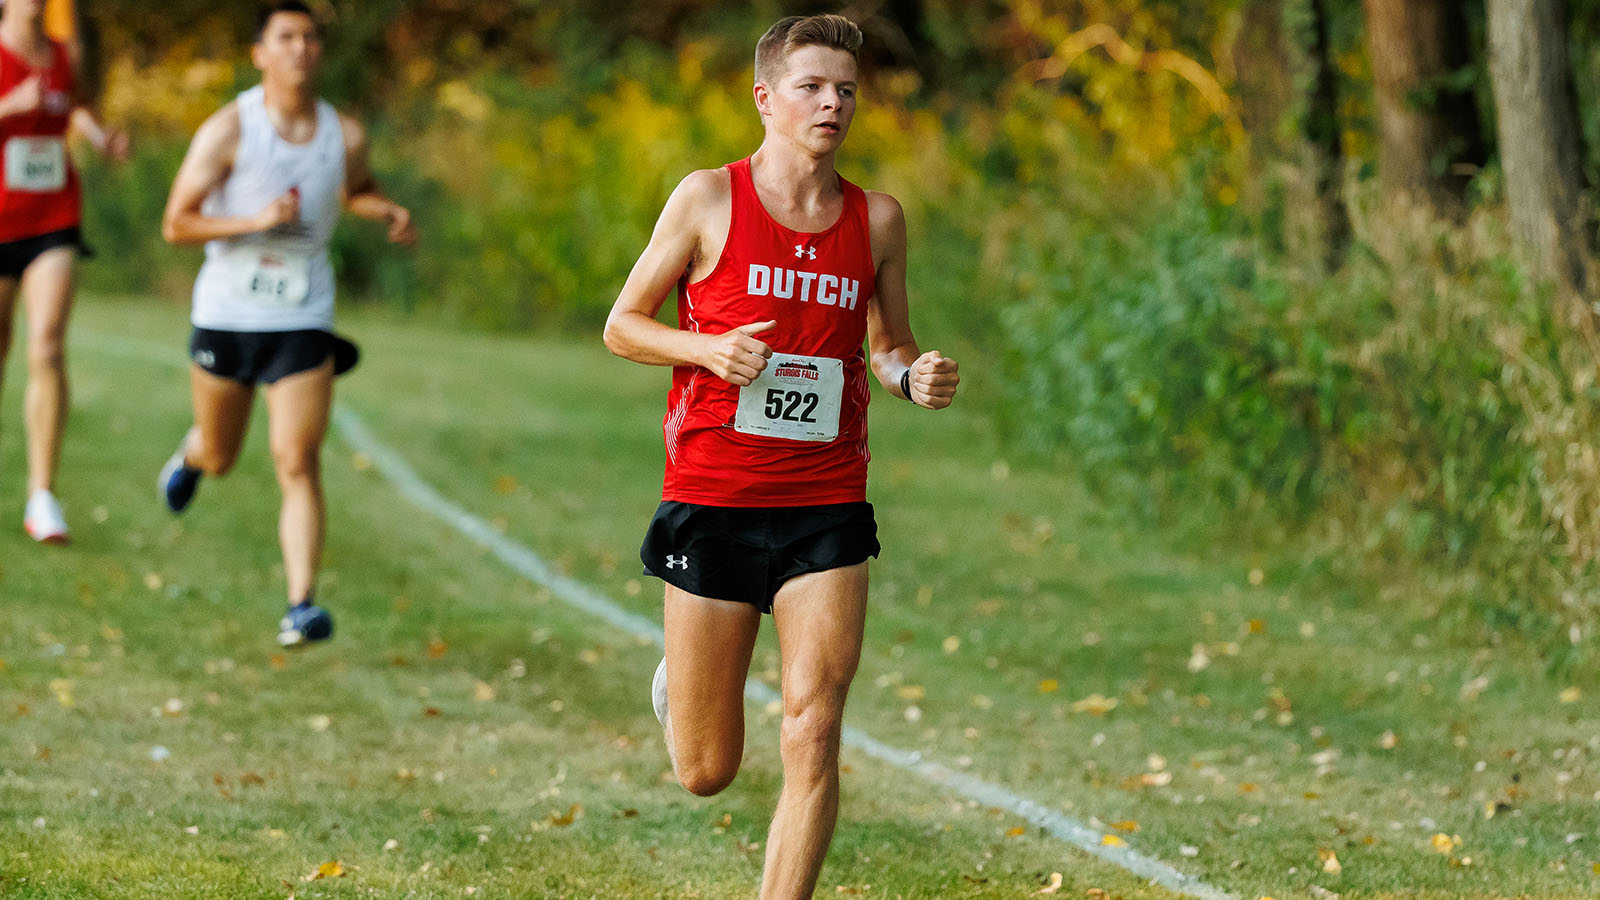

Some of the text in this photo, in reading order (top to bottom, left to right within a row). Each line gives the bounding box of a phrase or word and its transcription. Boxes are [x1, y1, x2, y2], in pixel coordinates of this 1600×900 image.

[747, 263, 860, 311] DUTCH
[774, 368, 820, 381] STURGIS FALLS
[764, 388, 819, 423] 522
